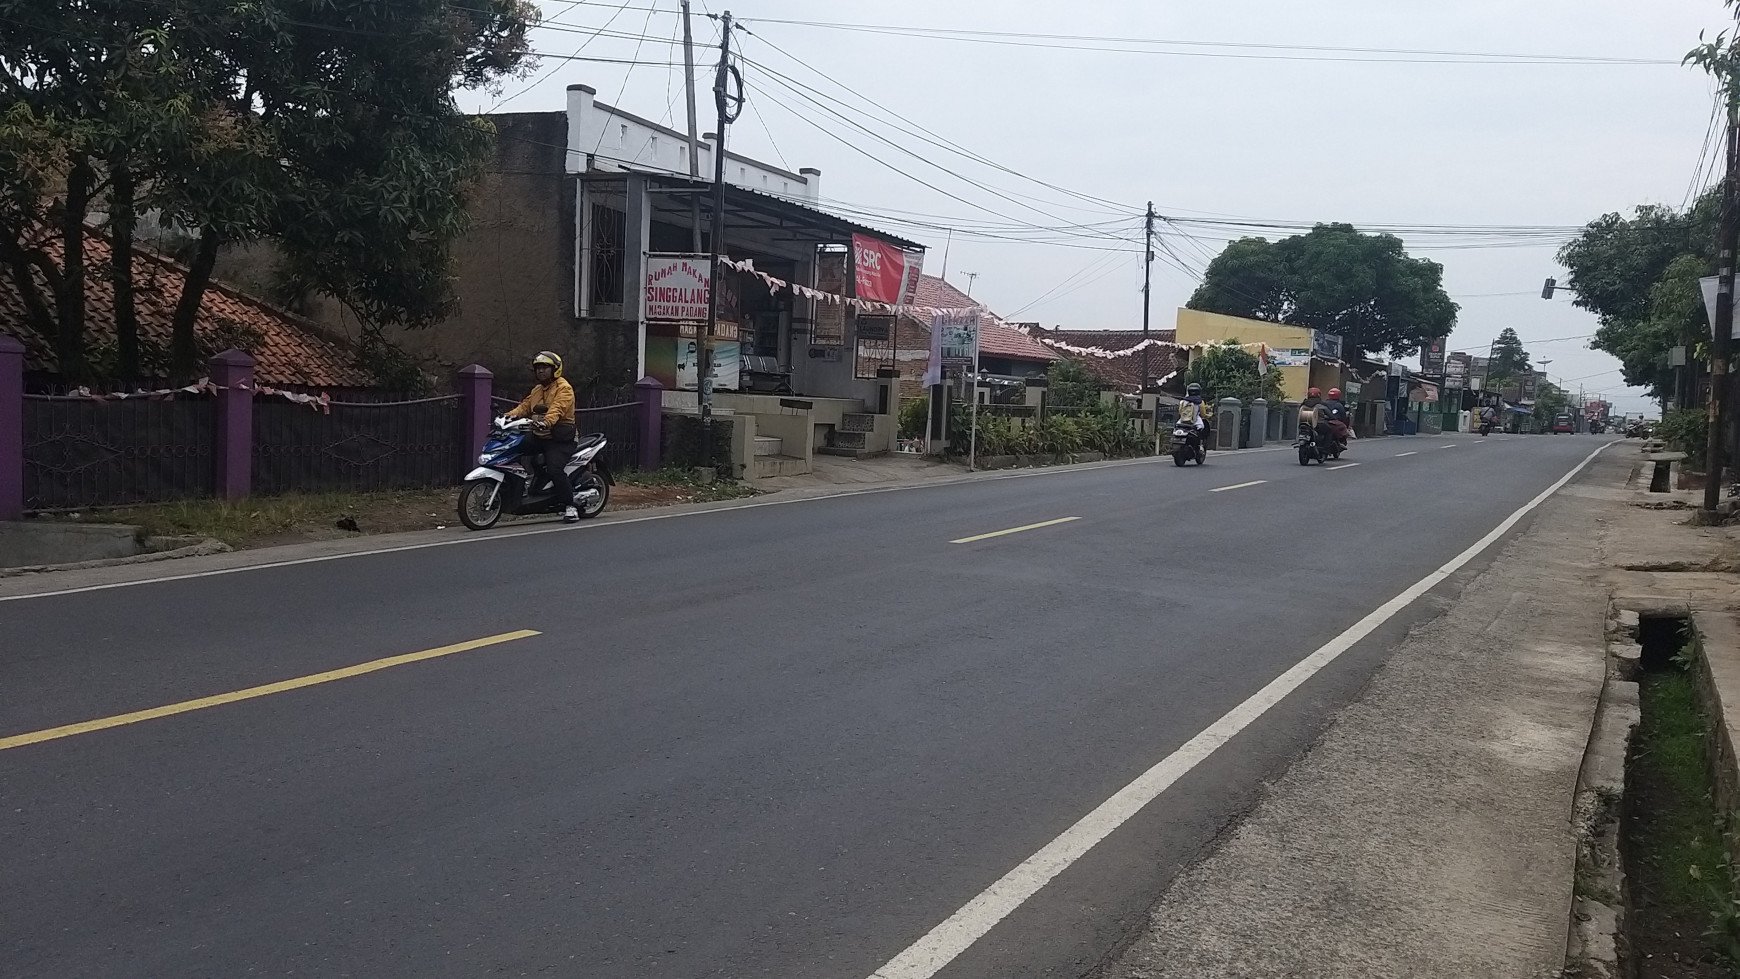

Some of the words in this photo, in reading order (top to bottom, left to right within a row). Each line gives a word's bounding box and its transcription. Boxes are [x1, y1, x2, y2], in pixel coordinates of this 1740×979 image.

[863, 248, 881, 270] SRC
[648, 262, 678, 286] RUMAH
[681, 261, 710, 288] MAKAN
[647, 287, 710, 305] SINGGALANG
[649, 304, 679, 317] MASAKAN
[681, 306, 707, 318] PADANG
